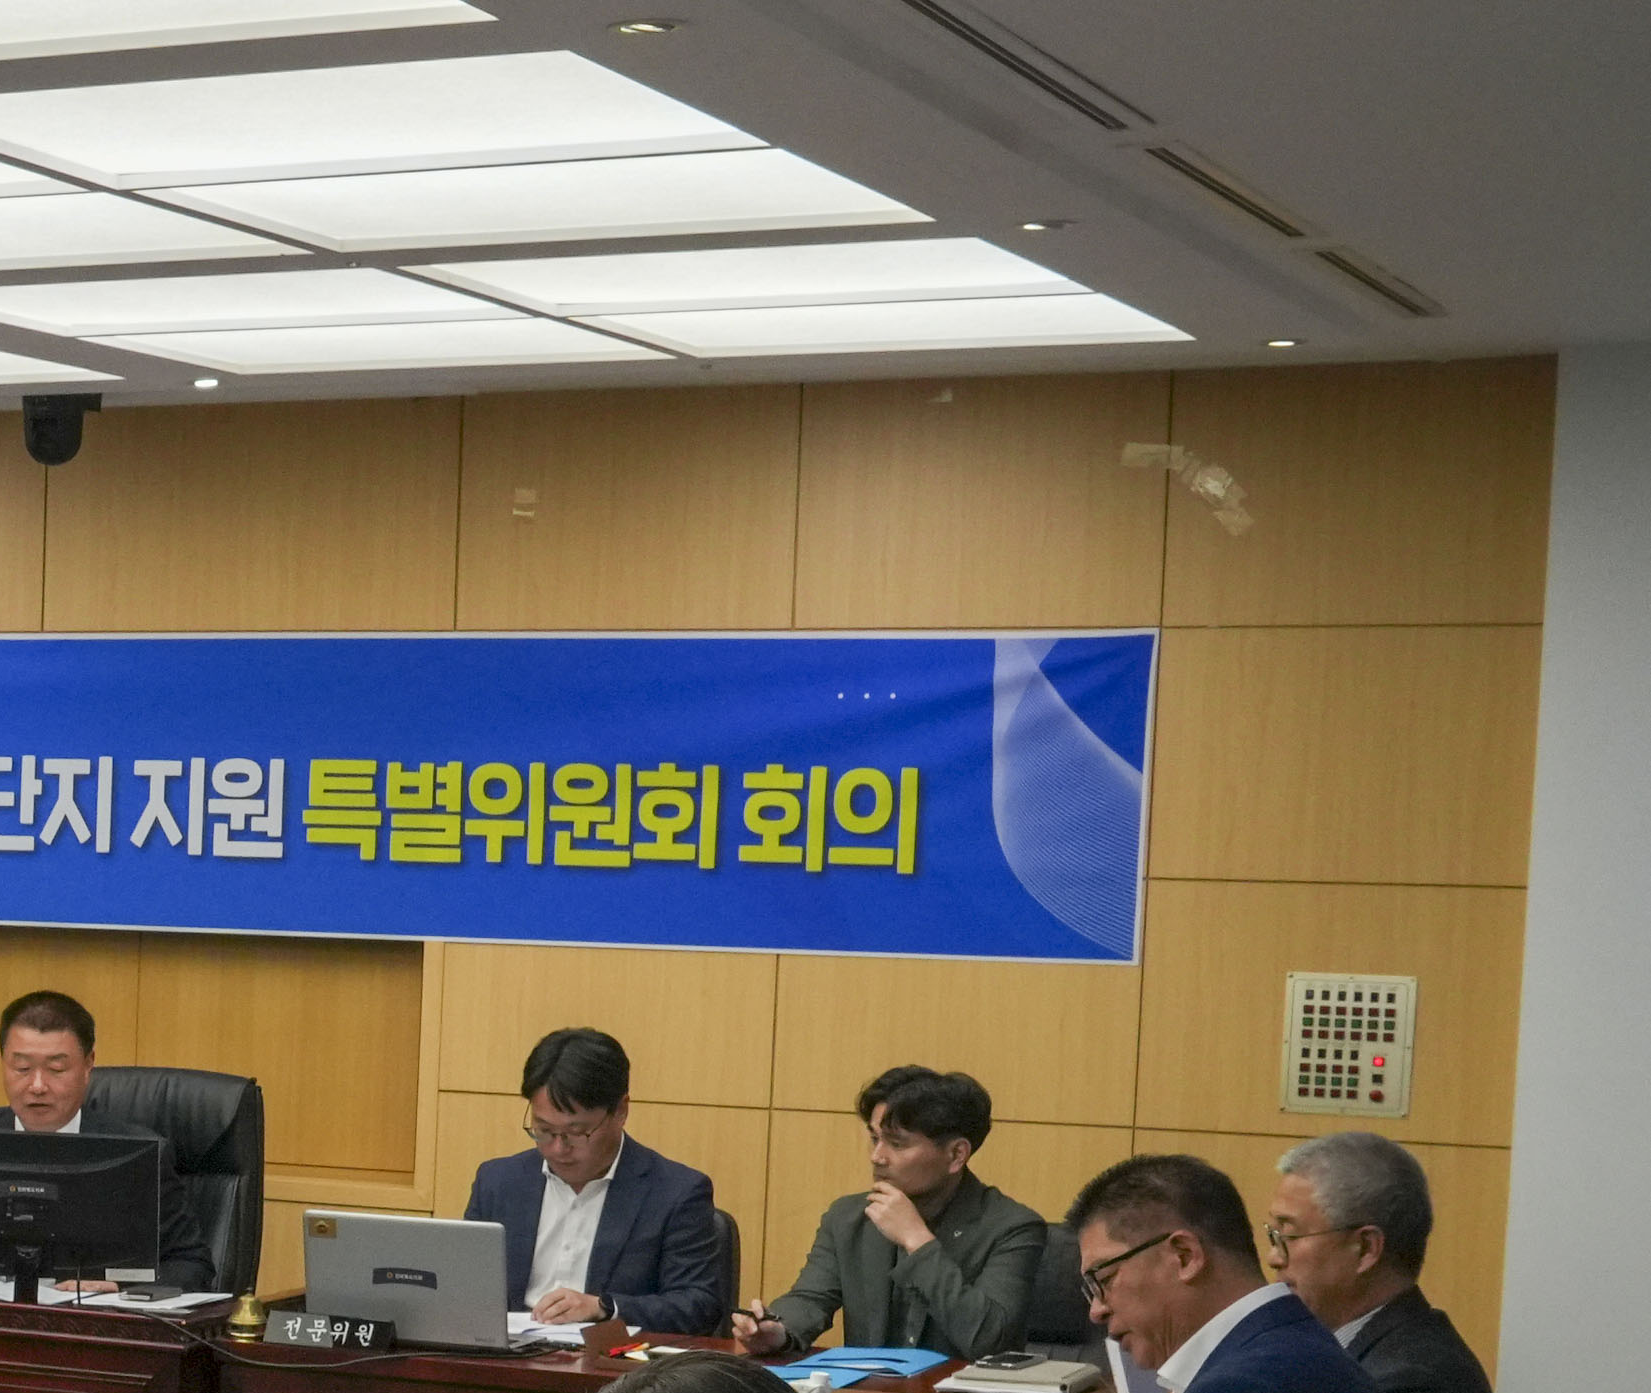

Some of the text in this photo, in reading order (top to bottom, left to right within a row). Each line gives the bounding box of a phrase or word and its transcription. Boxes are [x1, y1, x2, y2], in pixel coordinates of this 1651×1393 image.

[130, 756, 285, 859] 지원
[302, 758, 720, 870] 특별위원회
[738, 762, 918, 874] 회의
[283, 1316, 374, 1347] 전문위원
